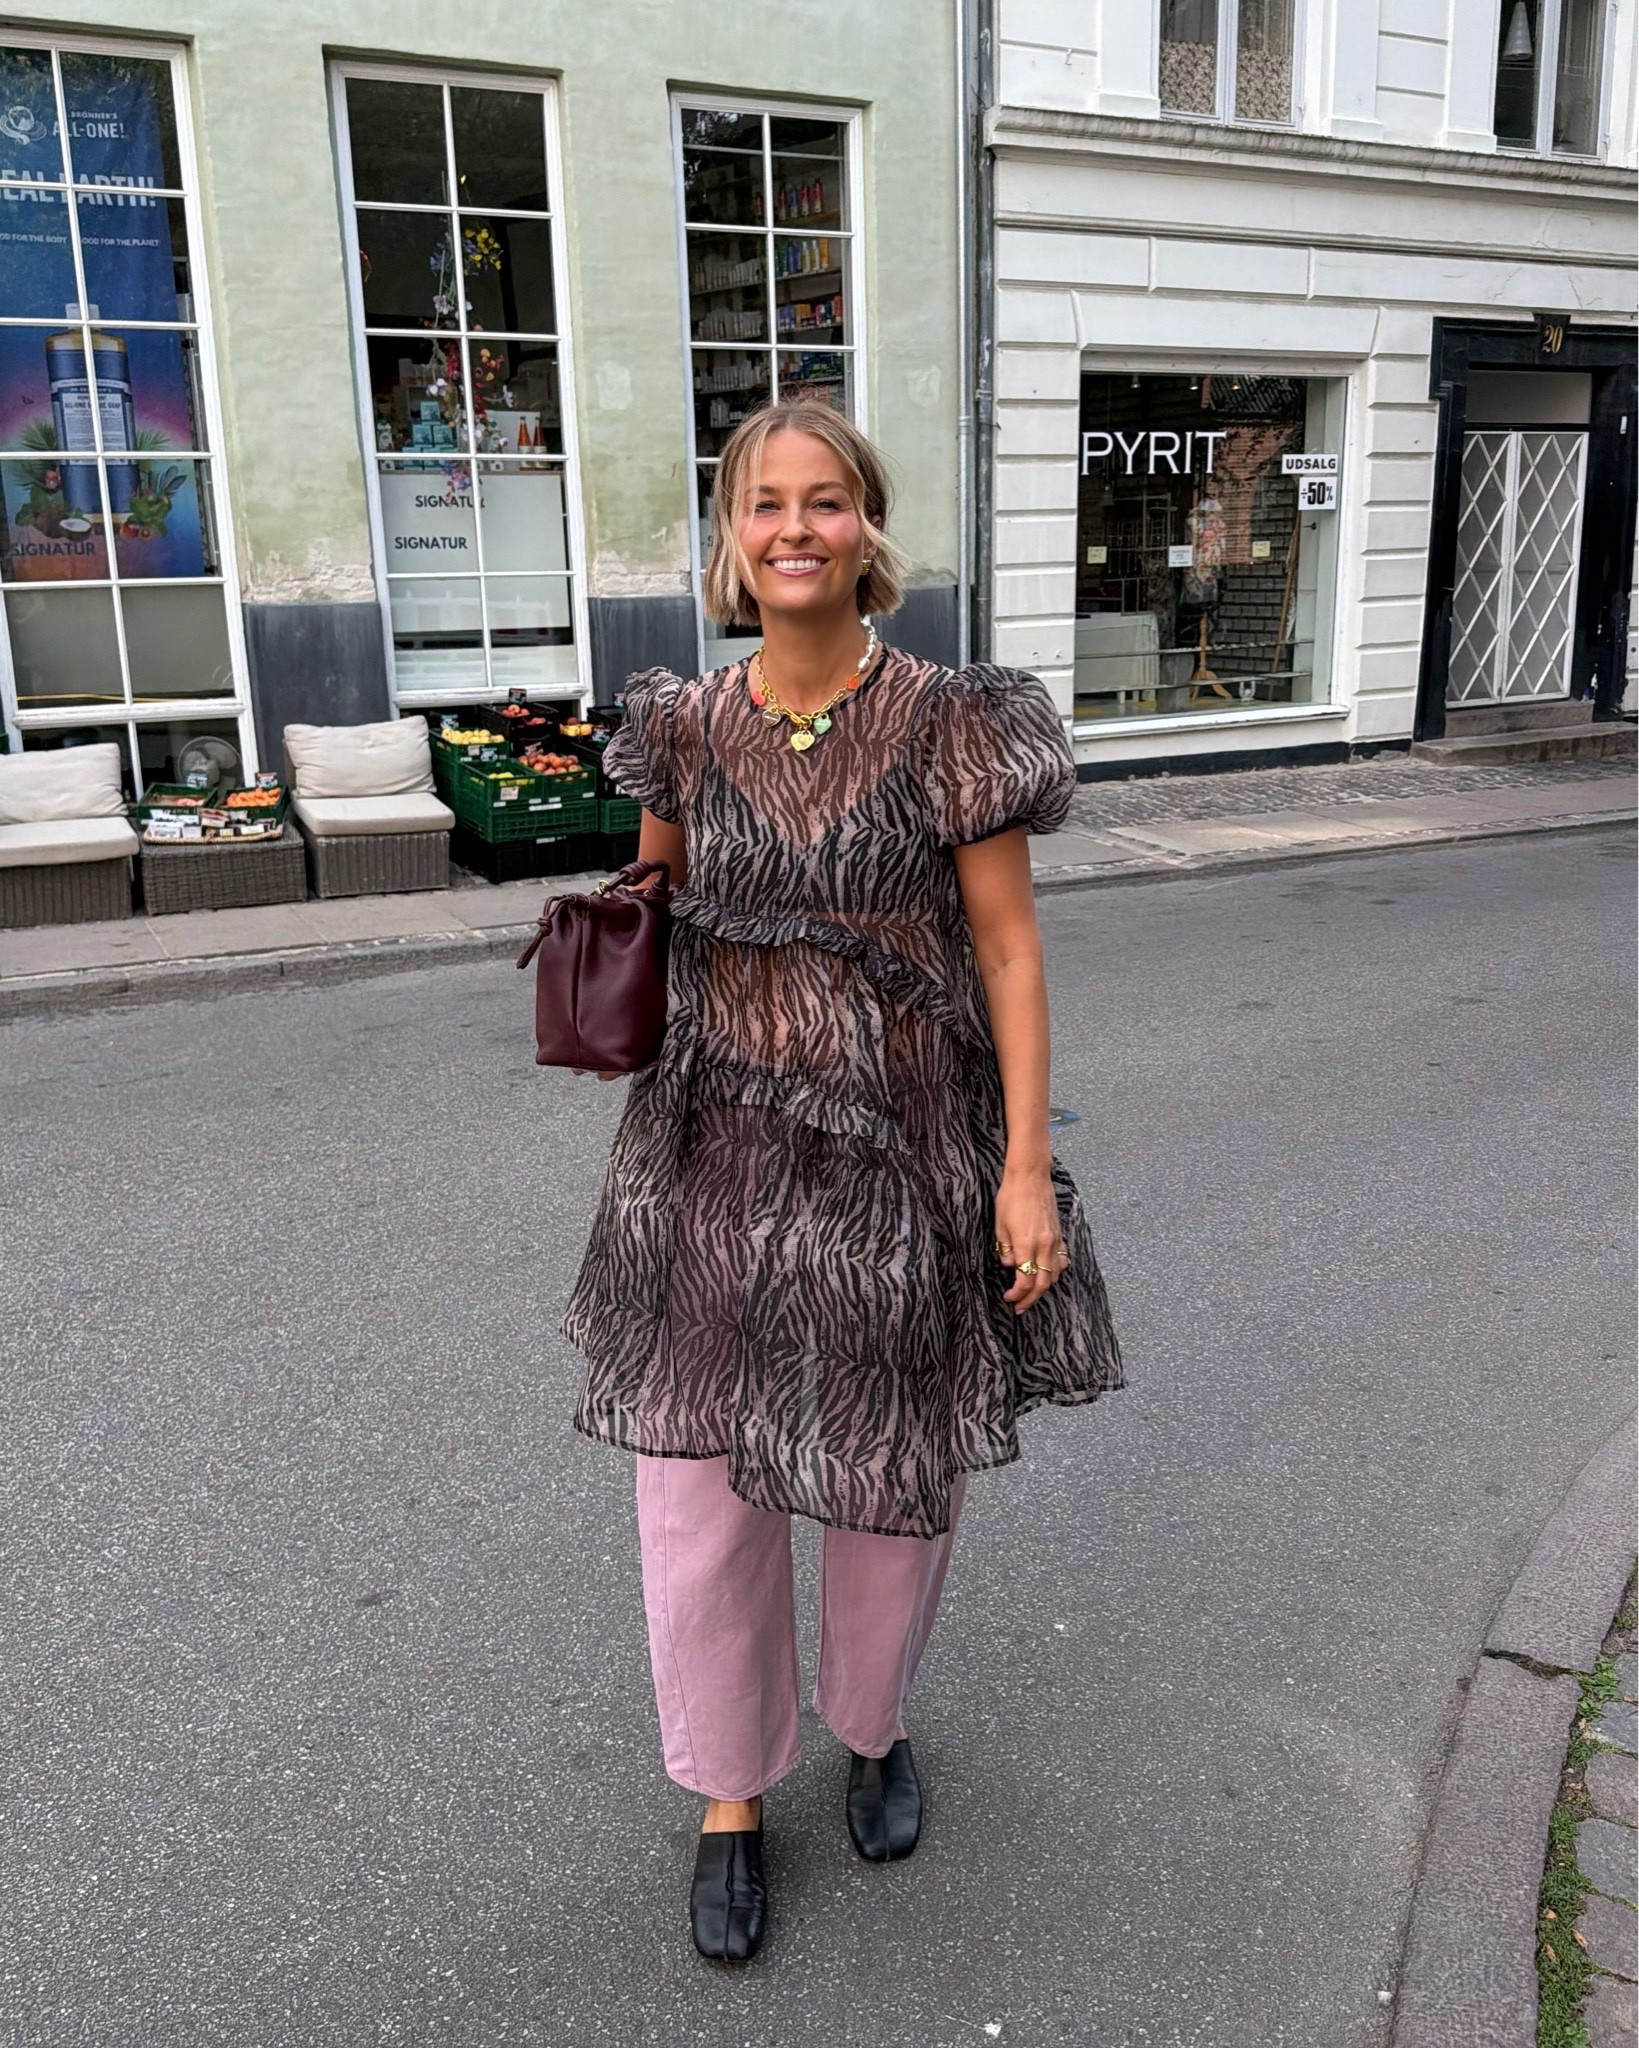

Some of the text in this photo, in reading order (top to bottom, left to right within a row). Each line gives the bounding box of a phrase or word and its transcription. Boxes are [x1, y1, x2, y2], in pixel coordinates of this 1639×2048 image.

[12, 233, 28, 242] FOR
[29, 234, 44, 243] THE
[1541, 324, 1563, 353] 20
[1080, 430, 1227, 475] PYRIT
[1285, 458, 1337, 470] UDSALG
[10, 542, 96, 556] SIGNATUR
[394, 536, 468, 550] SIGNATUR
